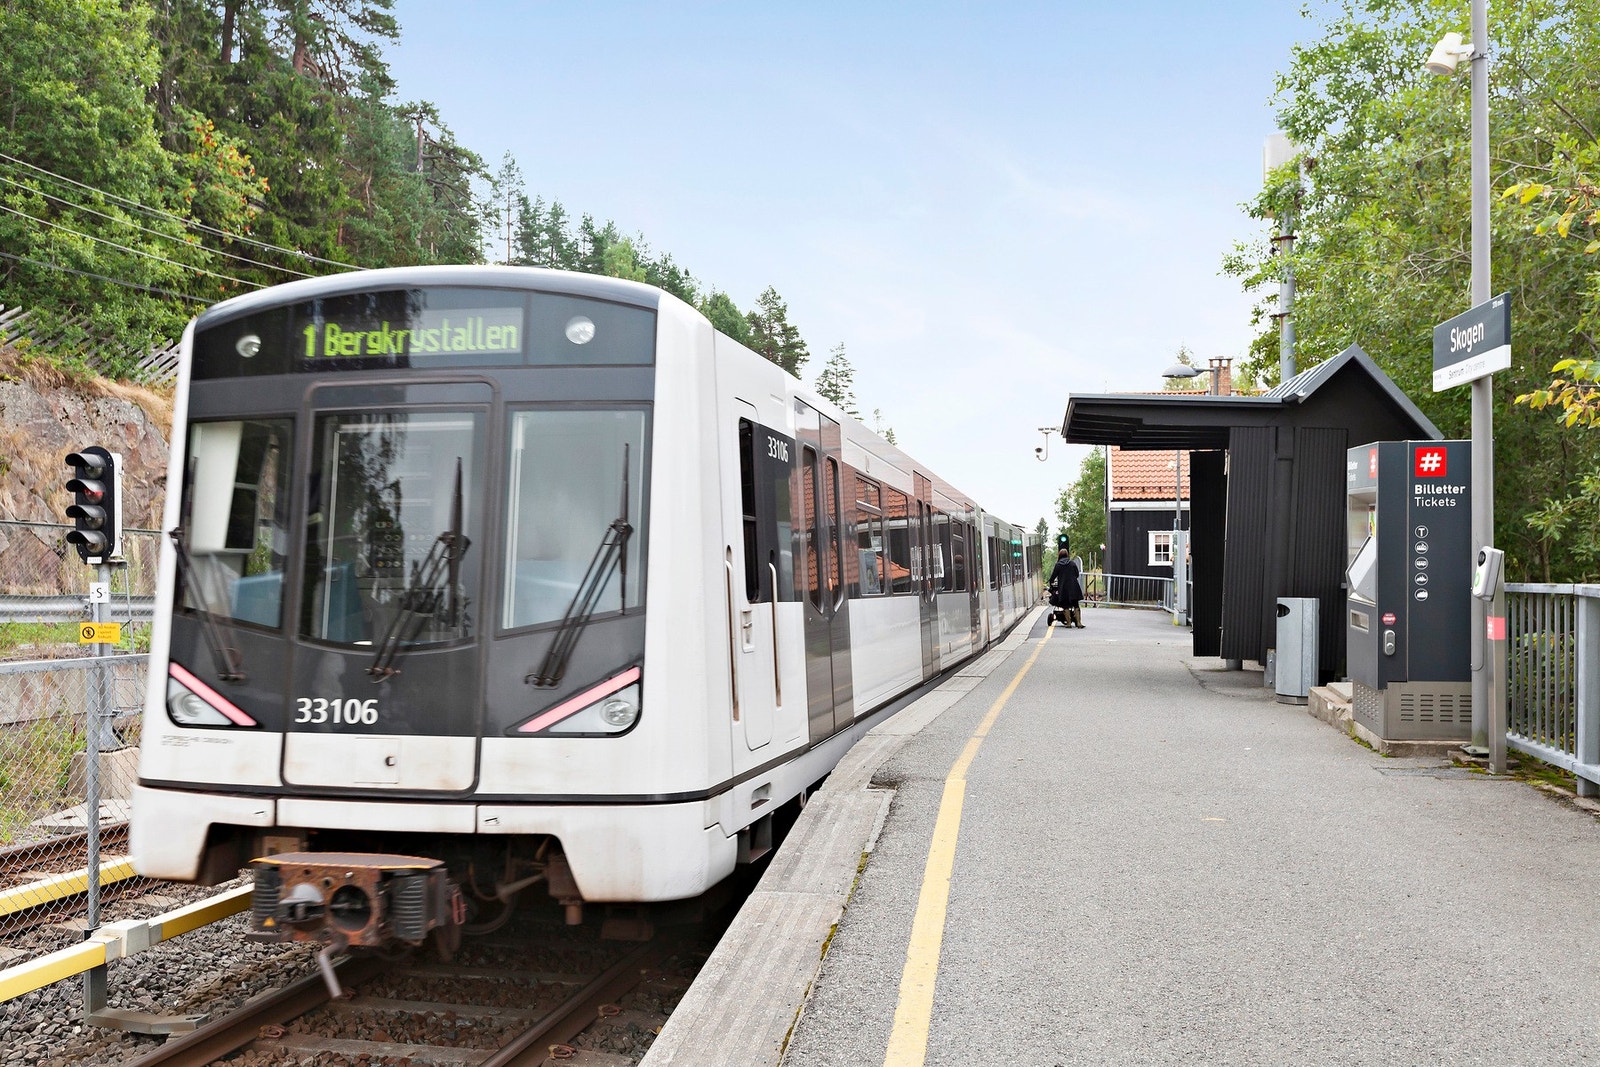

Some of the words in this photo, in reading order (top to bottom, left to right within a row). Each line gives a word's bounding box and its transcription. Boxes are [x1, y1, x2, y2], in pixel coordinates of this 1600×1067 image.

[303, 323, 316, 357] 1
[324, 316, 518, 356] Bergkrystallen
[1450, 322, 1484, 353] Skogen
[767, 435, 789, 463] 33106
[1414, 484, 1466, 495] Billetter
[1414, 496, 1457, 507] Tickets
[96, 587, 103, 599] S
[294, 697, 379, 724] 33106
